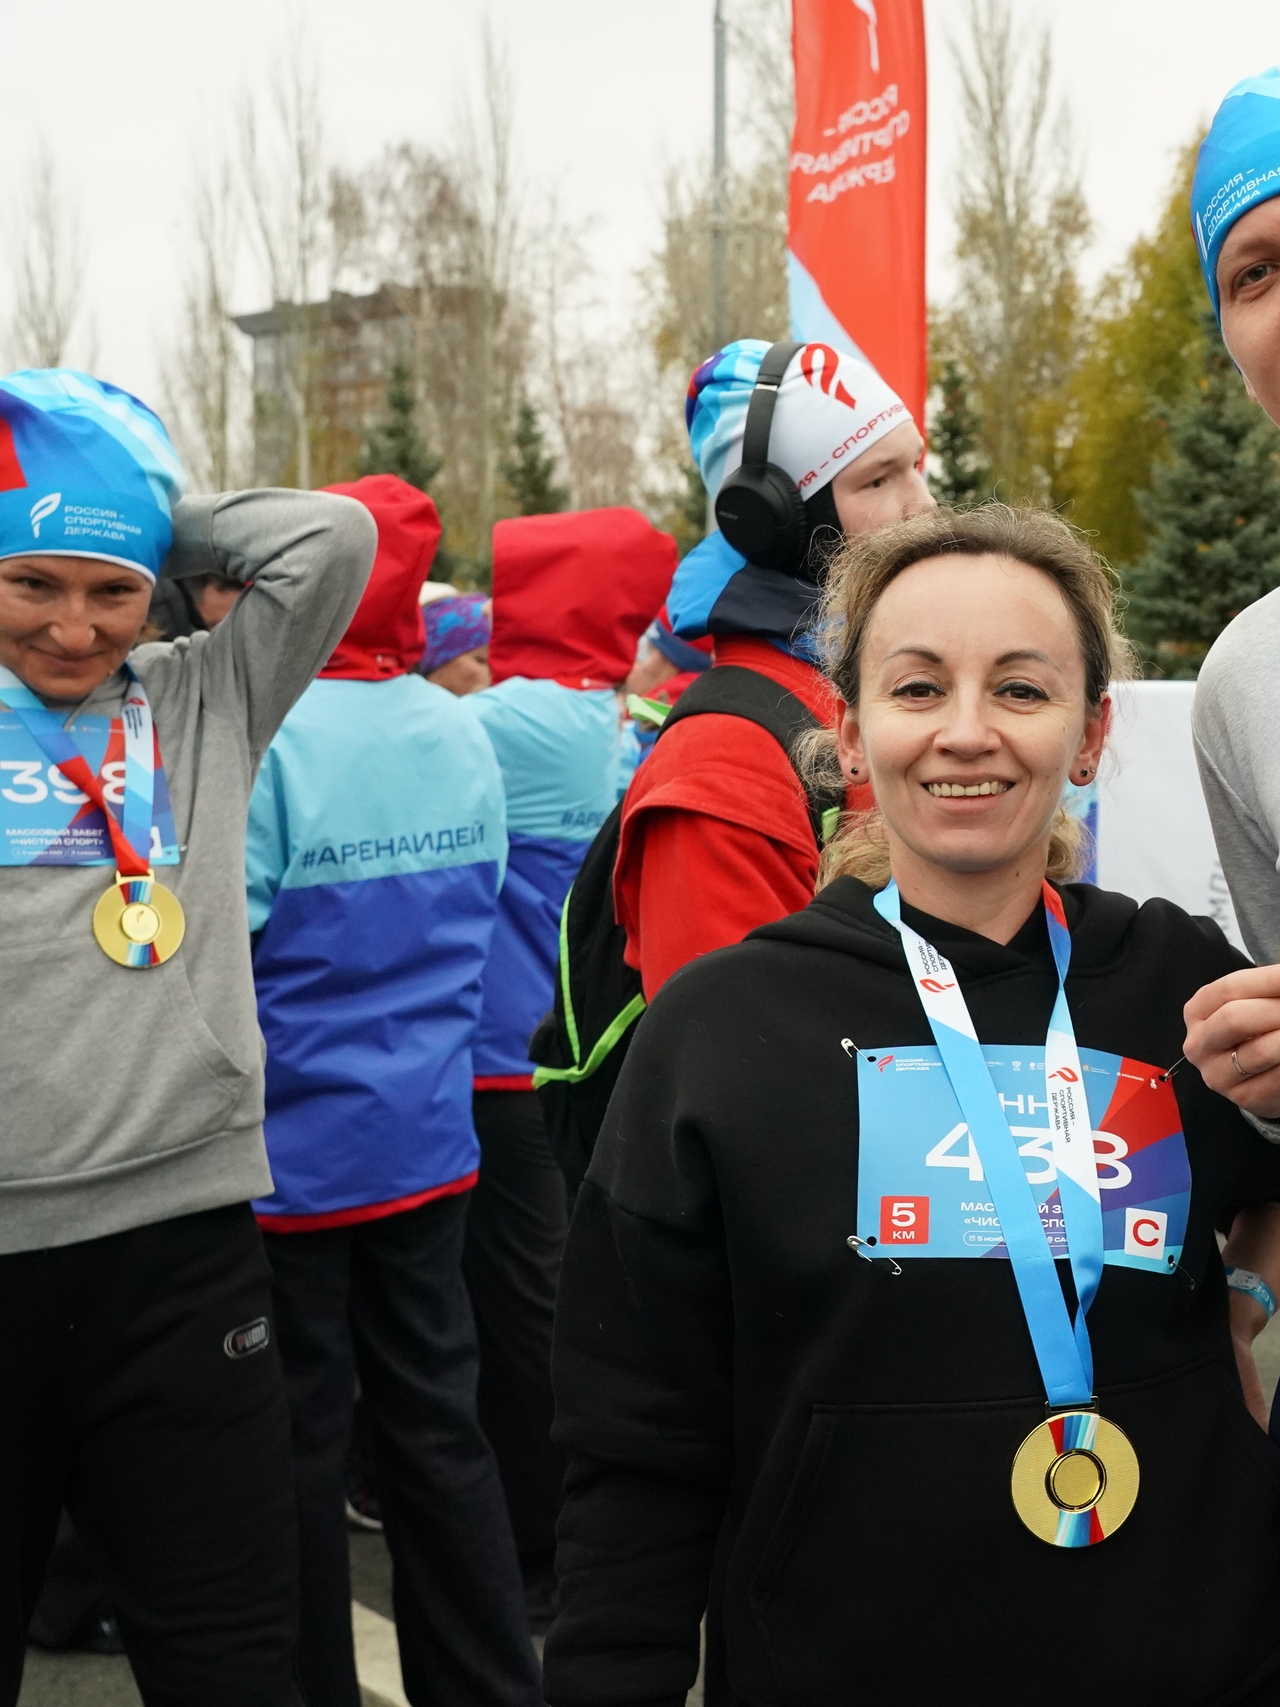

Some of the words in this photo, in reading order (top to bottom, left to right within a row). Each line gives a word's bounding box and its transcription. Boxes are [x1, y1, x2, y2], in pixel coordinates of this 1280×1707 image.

[1203, 173, 1244, 226] РОССИЯ
[64, 516, 142, 535] СПОРТИВНАЯ
[65, 505, 117, 518] РОССИЯ
[64, 526, 126, 541] ДЕРЖАВА
[6, 828, 70, 837] МАССОВЫЙ
[71, 828, 104, 837] ЗАБЕГ
[302, 821, 484, 869] #АРЕНАИДЕЙ
[918, 946, 932, 974] РОССИЯ
[1051, 1092, 1061, 1131] ДЕРЖАВА
[1059, 1089, 1071, 1143] СПОРТИВНАЯ
[1066, 1086, 1075, 1120] РОССИЯ
[925, 1122, 1132, 1190] 438
[891, 1202, 916, 1227] 5
[892, 1231, 915, 1240] КМ
